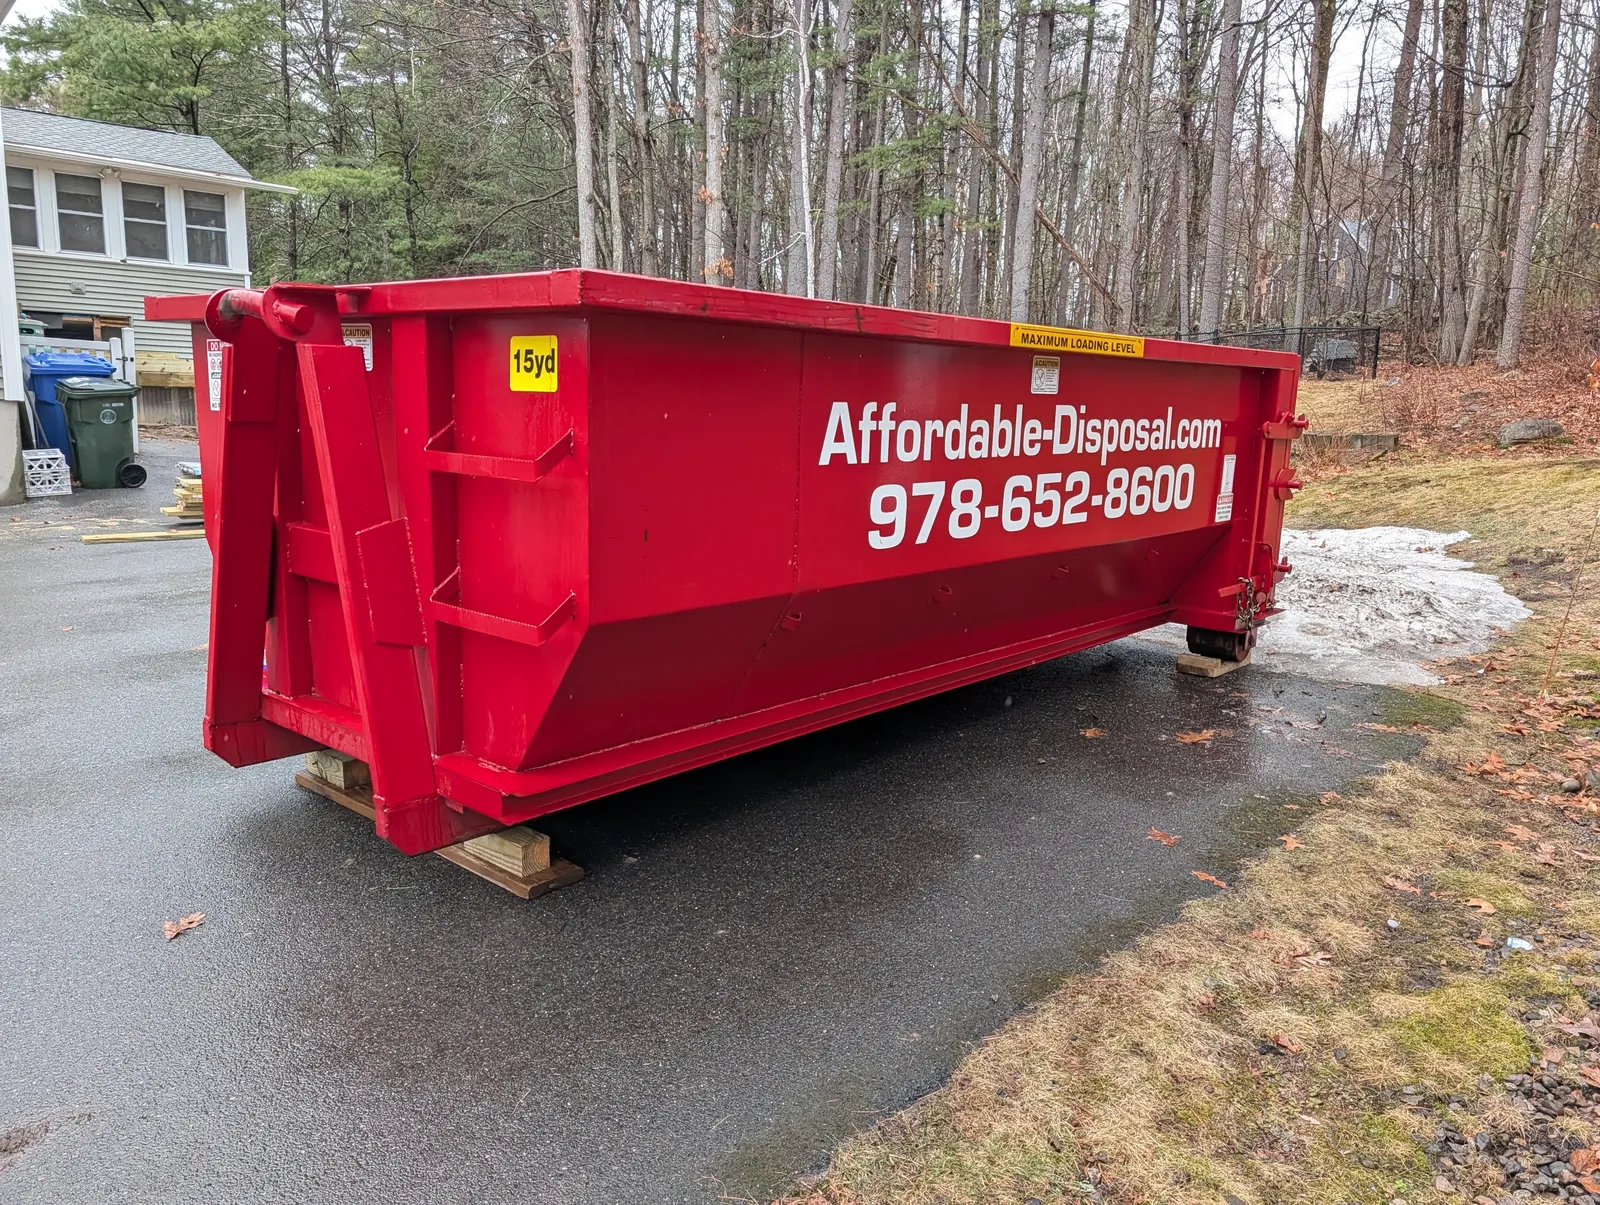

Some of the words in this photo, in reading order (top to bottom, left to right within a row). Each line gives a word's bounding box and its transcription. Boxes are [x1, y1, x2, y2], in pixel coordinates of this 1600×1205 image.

[345, 329, 370, 337] CAUTION
[1020, 333, 1069, 348] MAXIMUM
[1071, 337, 1109, 352] LOADING
[1111, 342, 1136, 354] LEVEL
[513, 347, 556, 379] 15yd
[1038, 359, 1059, 368] CAUTION
[818, 401, 1222, 466] Affordable-Disposal.com
[867, 463, 1195, 550] 978-652-8600
